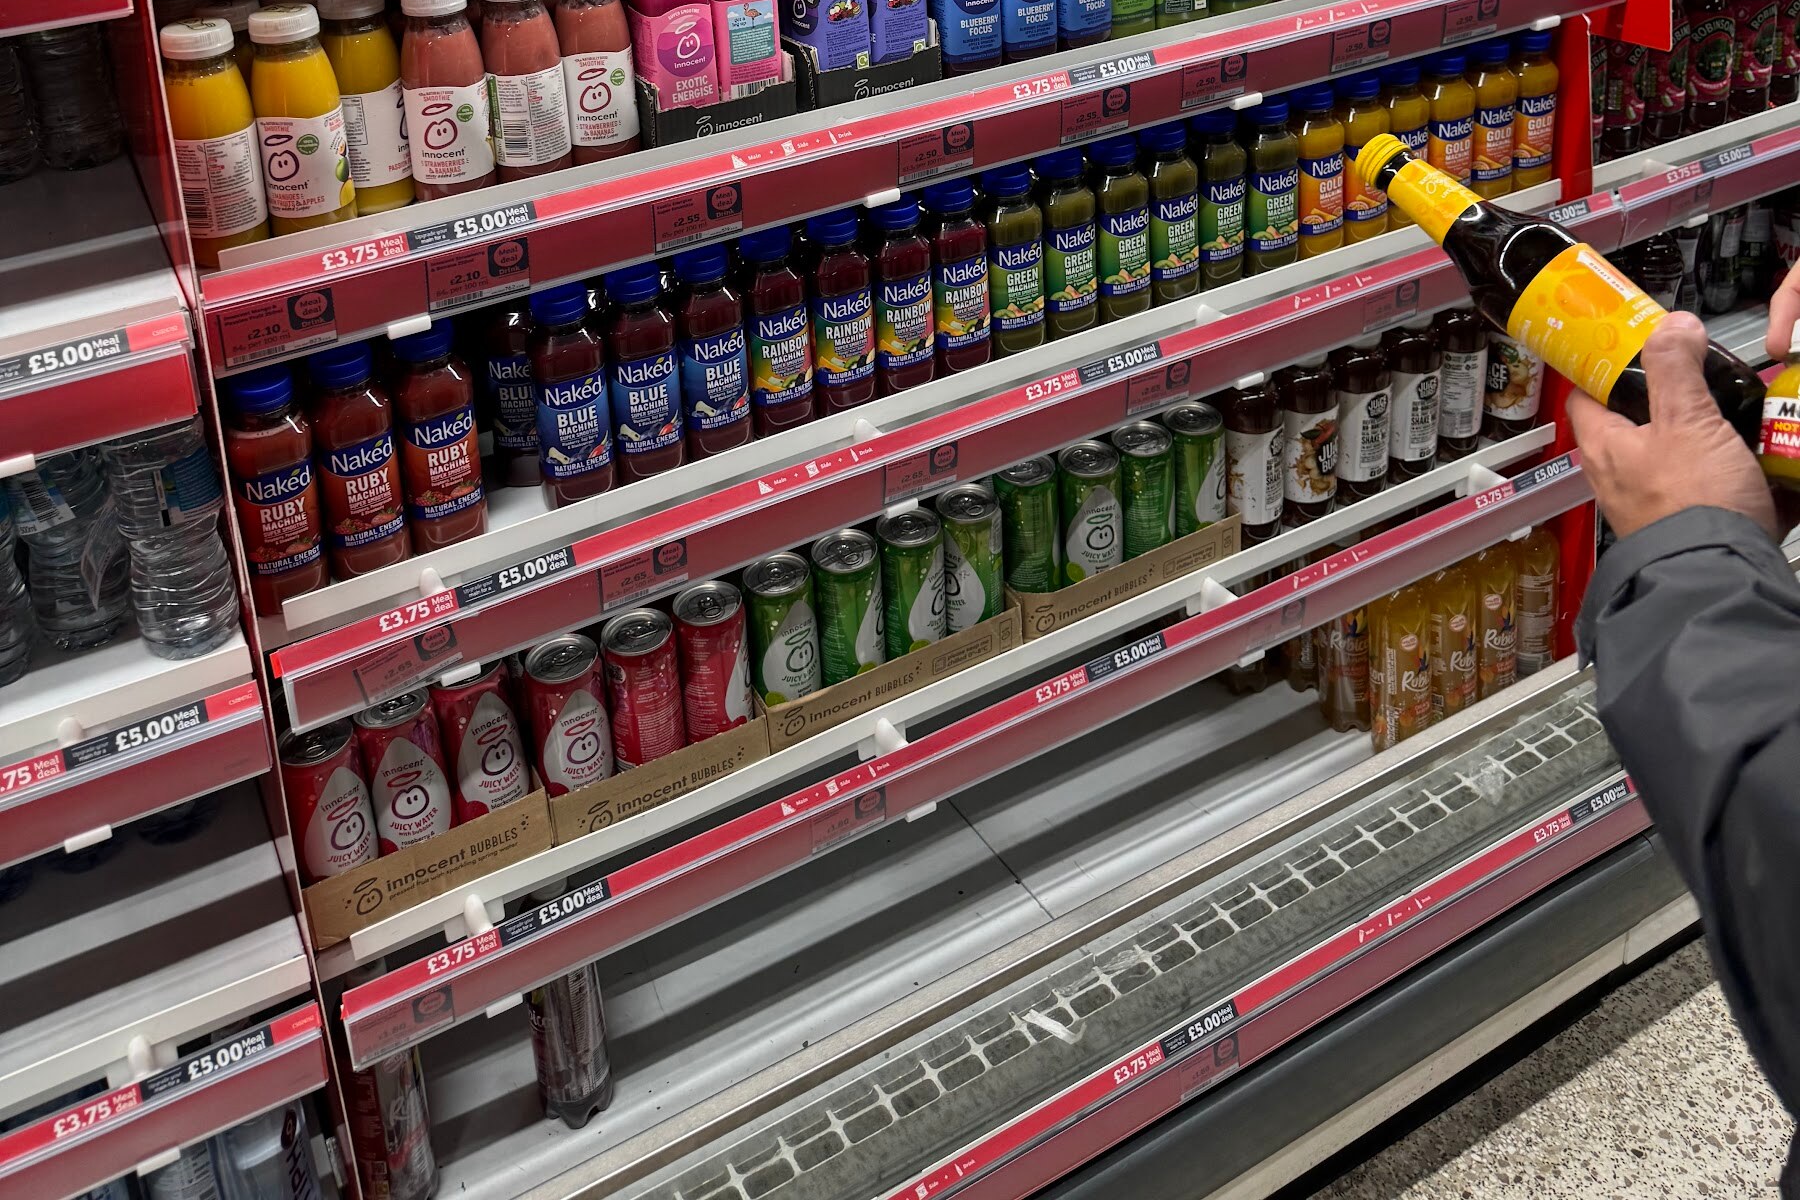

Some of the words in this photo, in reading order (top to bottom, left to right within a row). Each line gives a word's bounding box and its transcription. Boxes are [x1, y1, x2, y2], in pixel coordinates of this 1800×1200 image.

[960, 15, 998, 29] BLUEBERRY
[969, 25, 992, 35] FOCUS
[674, 57, 706, 69] innocent
[1100, 59, 1136, 76] £5.00
[675, 76, 709, 91] EXOTIC
[1013, 81, 1050, 98] £3.75
[672, 85, 713, 103] ENERGISE
[577, 110, 619, 122] innocent
[715, 114, 763, 132] innocent
[421, 147, 465, 159] innocent
[424, 157, 465, 168] STRAWBERRIES
[1719, 151, 1742, 166] £5.00
[434, 166, 461, 175] BANANAS
[1667, 167, 1691, 183] £3.75
[1320, 178, 1342, 193] GOLD
[506, 206, 529, 217] Meal
[508, 215, 530, 226] deal
[1549, 205, 1576, 223] £5.00
[454, 212, 507, 238] £5.00
[322, 244, 379, 270] £3.75
[999, 242, 1042, 267] Naked
[1007, 268, 1038, 285] GREEN
[823, 294, 871, 319] Naked
[247, 324, 280, 339] £2.10
[825, 316, 871, 338] RAINBOW
[545, 377, 602, 406] Naked
[557, 406, 596, 427] BLUE
[414, 413, 473, 445] Naked
[427, 442, 468, 465] RUBY
[429, 457, 470, 476] MACHINE
[424, 500, 455, 514] NATURAL
[457, 490, 481, 504] ENERGY
[546, 550, 568, 563] Meal
[548, 557, 568, 570] deal
[499, 559, 548, 588] £5.00
[379, 602, 430, 632] £3.75
[1114, 642, 1148, 668] £5.00
[809, 688, 872, 722] innocent
[874, 672, 914, 696] BUBBLES
[1036, 678, 1071, 703] £3.75
[115, 713, 175, 751] £5.00
[381, 758, 423, 777] innocent
[390, 820, 413, 833] JUICY
[415, 809, 438, 825] WATER
[386, 849, 466, 892] innocent
[470, 827, 518, 858] BUBBLES
[1188, 1012, 1221, 1042] £5.00
[1113, 1054, 1147, 1084] £3.75
[52, 1099, 111, 1138] £3.75
